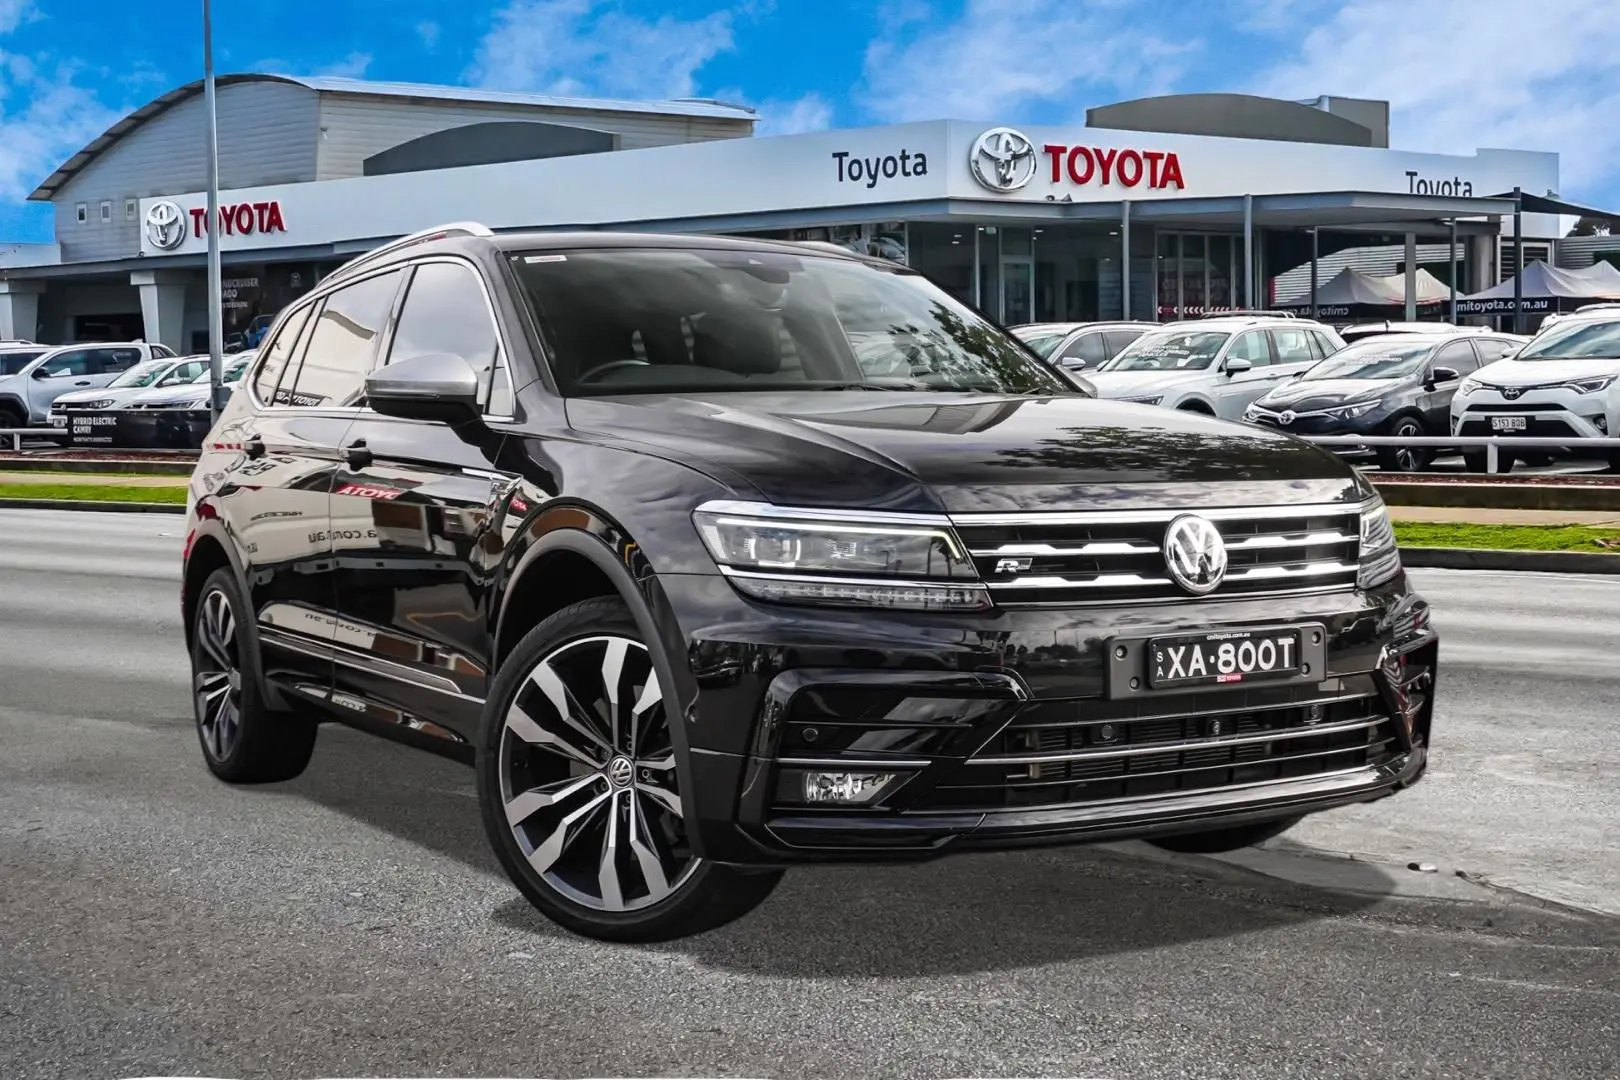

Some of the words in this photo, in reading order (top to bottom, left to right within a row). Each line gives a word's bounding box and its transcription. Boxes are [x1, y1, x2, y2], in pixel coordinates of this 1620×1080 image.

[832, 148, 928, 189] Toyota
[1043, 143, 1185, 189] TOYOTA
[1405, 171, 1473, 197] Toyota
[1456, 300, 1548, 313] mitoyota.cm.au
